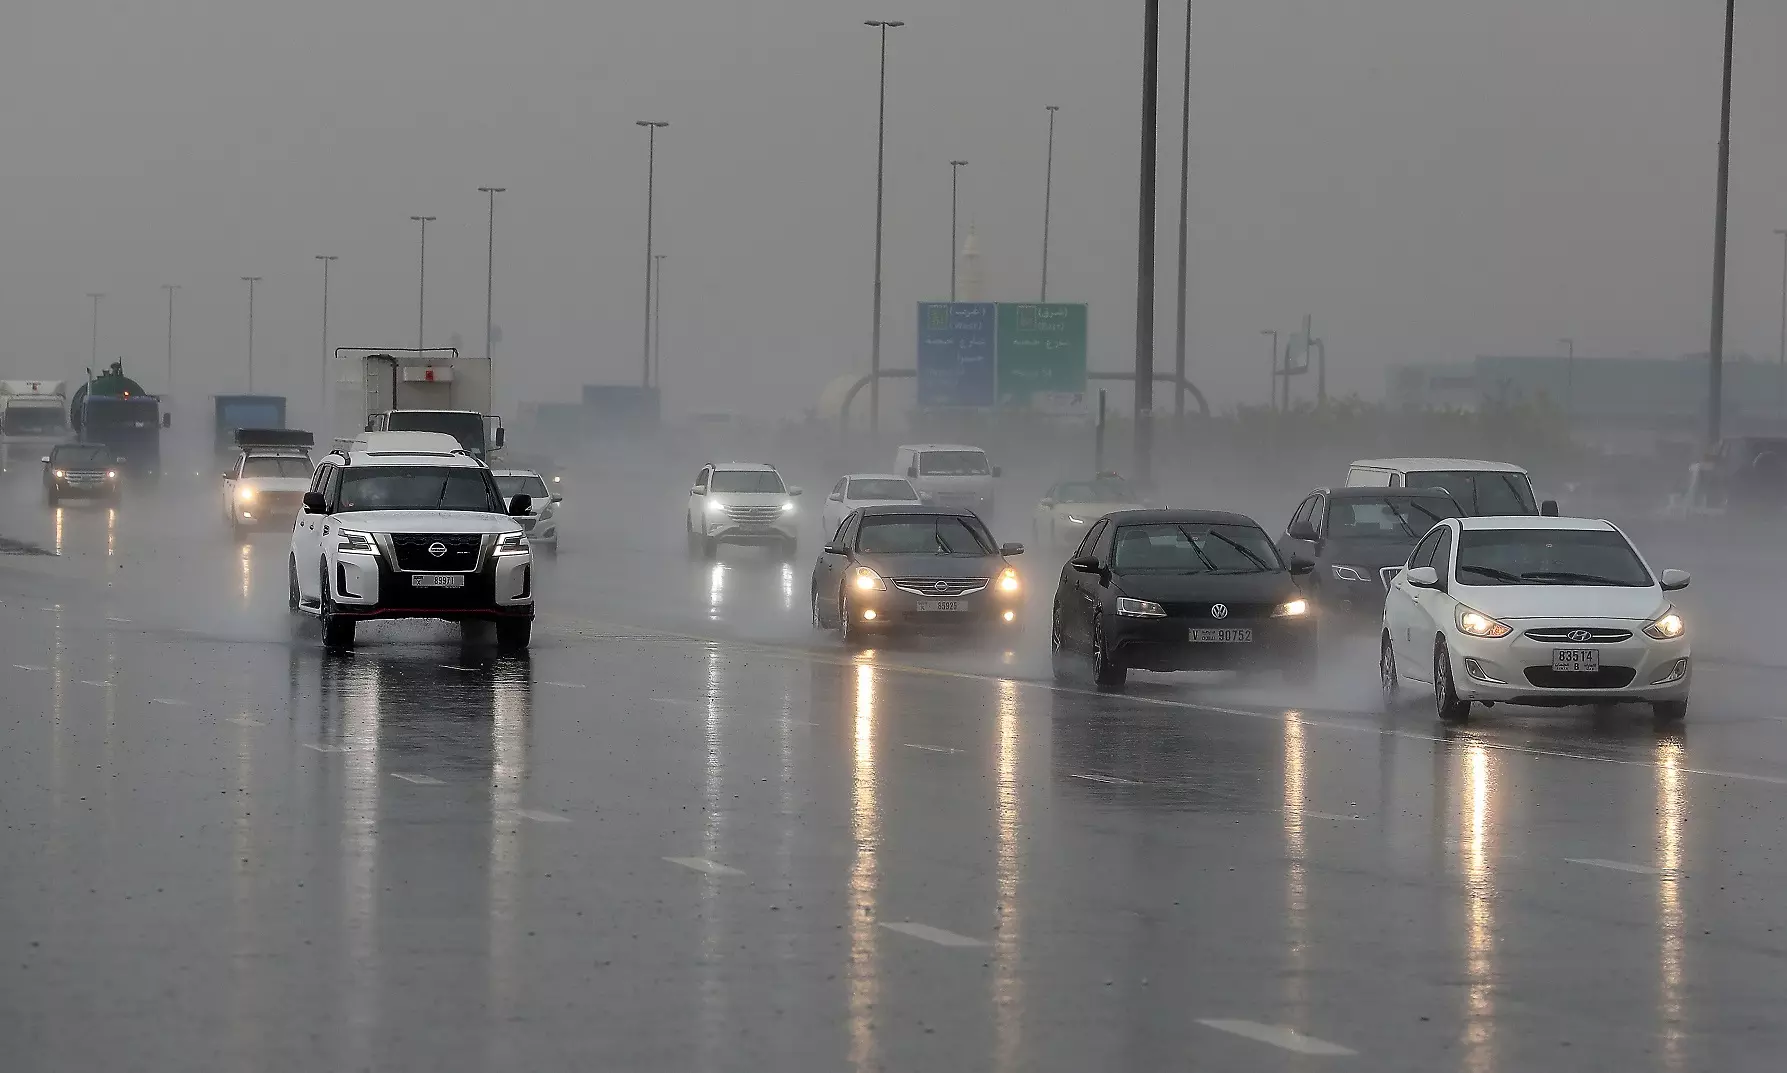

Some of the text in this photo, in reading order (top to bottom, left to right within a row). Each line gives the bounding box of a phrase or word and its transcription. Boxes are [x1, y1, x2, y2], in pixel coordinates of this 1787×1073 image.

[434, 576, 454, 585] 89971
[1218, 630, 1251, 641] 90752
[1559, 650, 1593, 662] 83514
